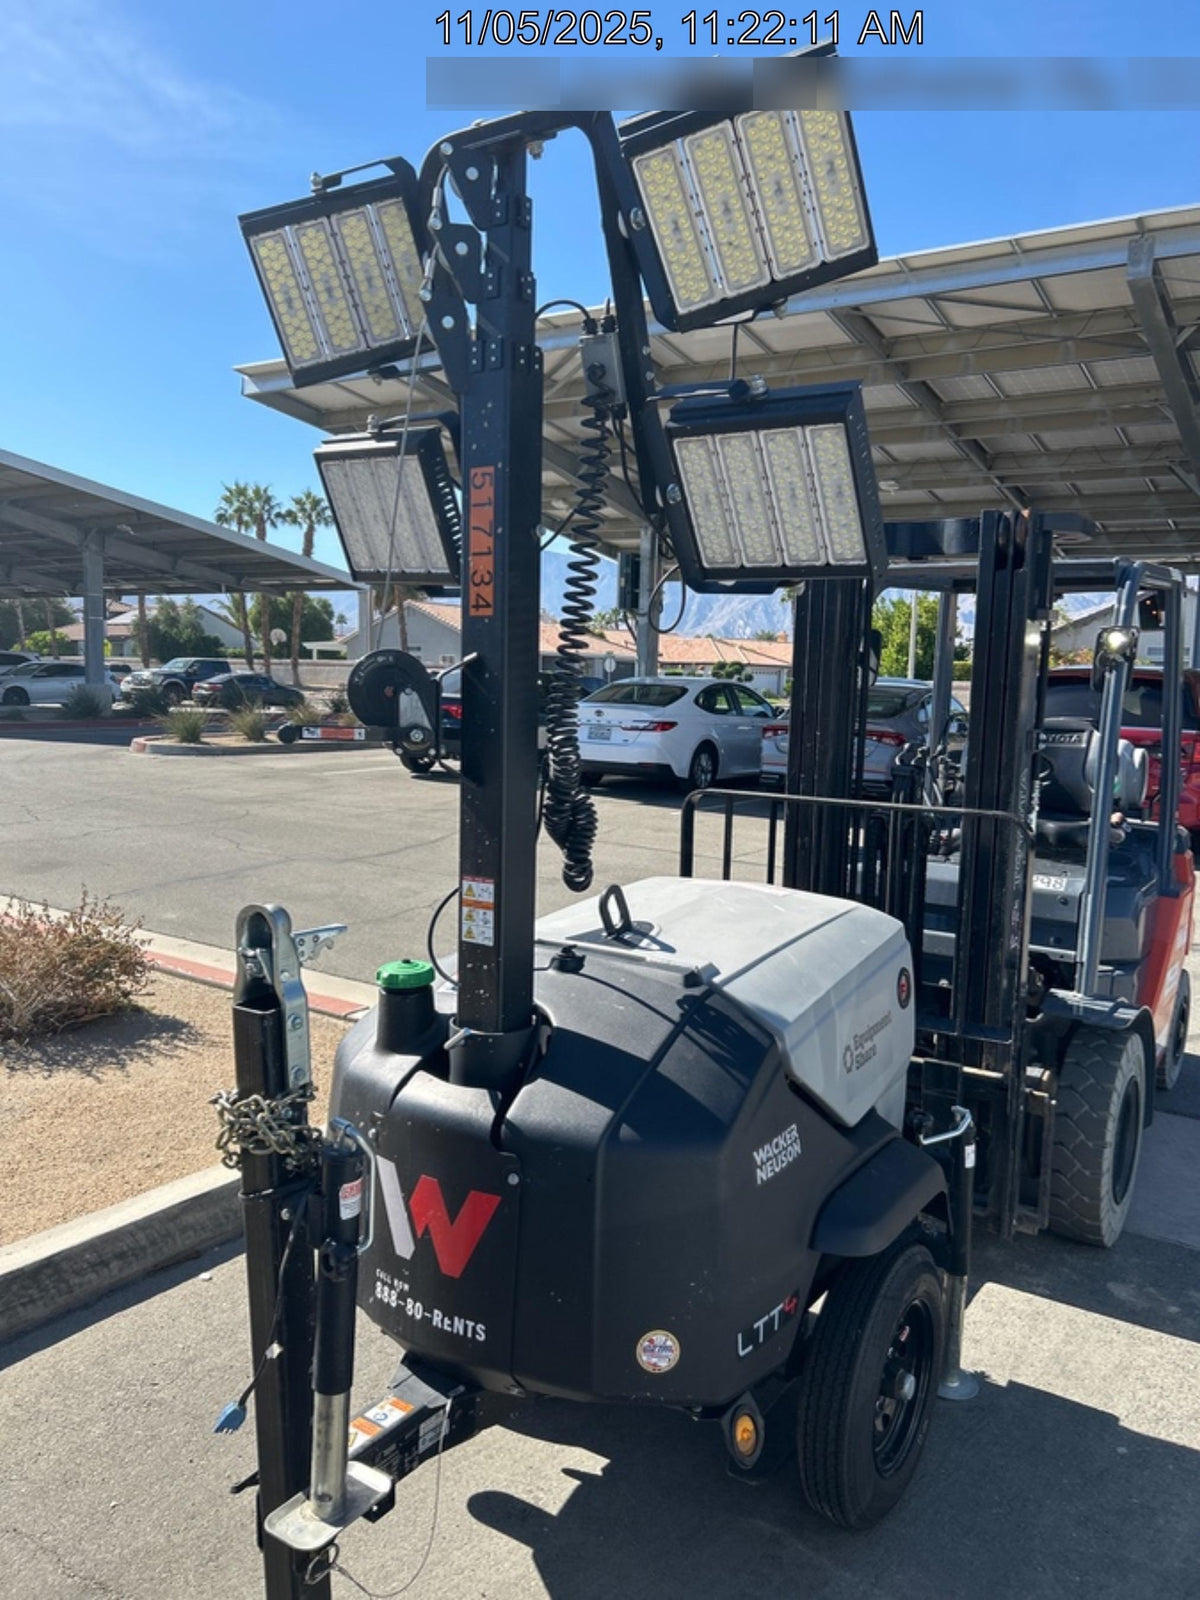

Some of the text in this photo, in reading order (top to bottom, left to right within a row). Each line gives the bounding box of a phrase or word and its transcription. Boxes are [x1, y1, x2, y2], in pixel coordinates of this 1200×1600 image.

[471, 471, 493, 612] 517134
[753, 1123, 799, 1166] WACKER
[756, 1138, 802, 1185] NEUSON
